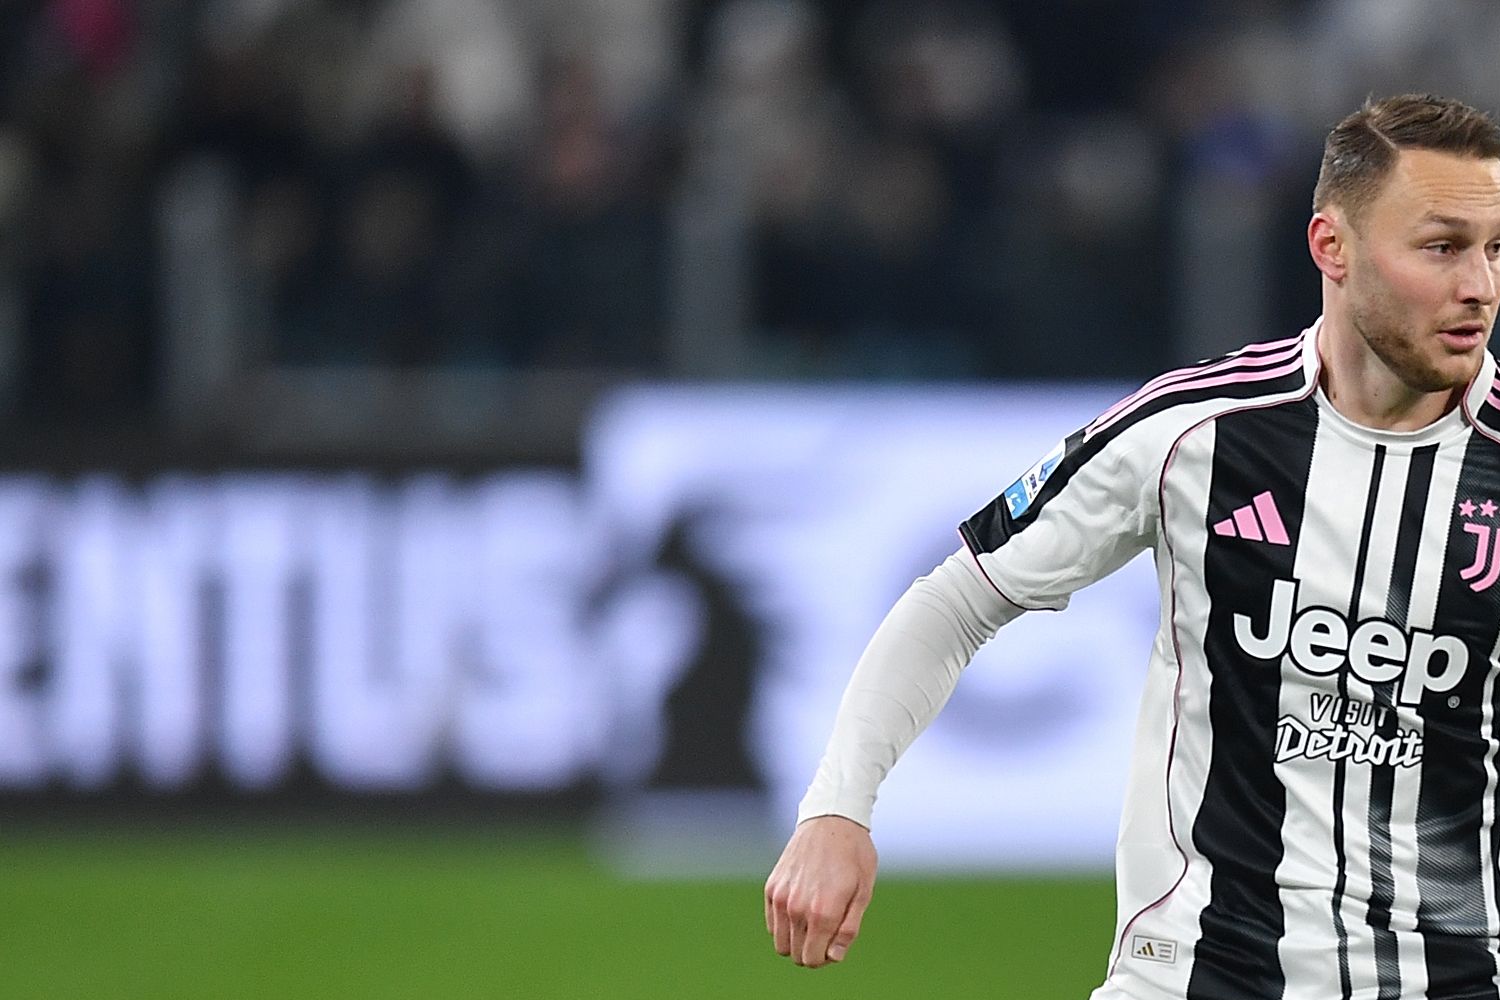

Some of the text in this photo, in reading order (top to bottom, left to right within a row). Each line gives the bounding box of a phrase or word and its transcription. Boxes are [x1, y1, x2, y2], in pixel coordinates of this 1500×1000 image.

[1233, 578, 1469, 705] Jeep
[1311, 693, 1390, 728] VISIT
[1275, 715, 1423, 767] Detroit
